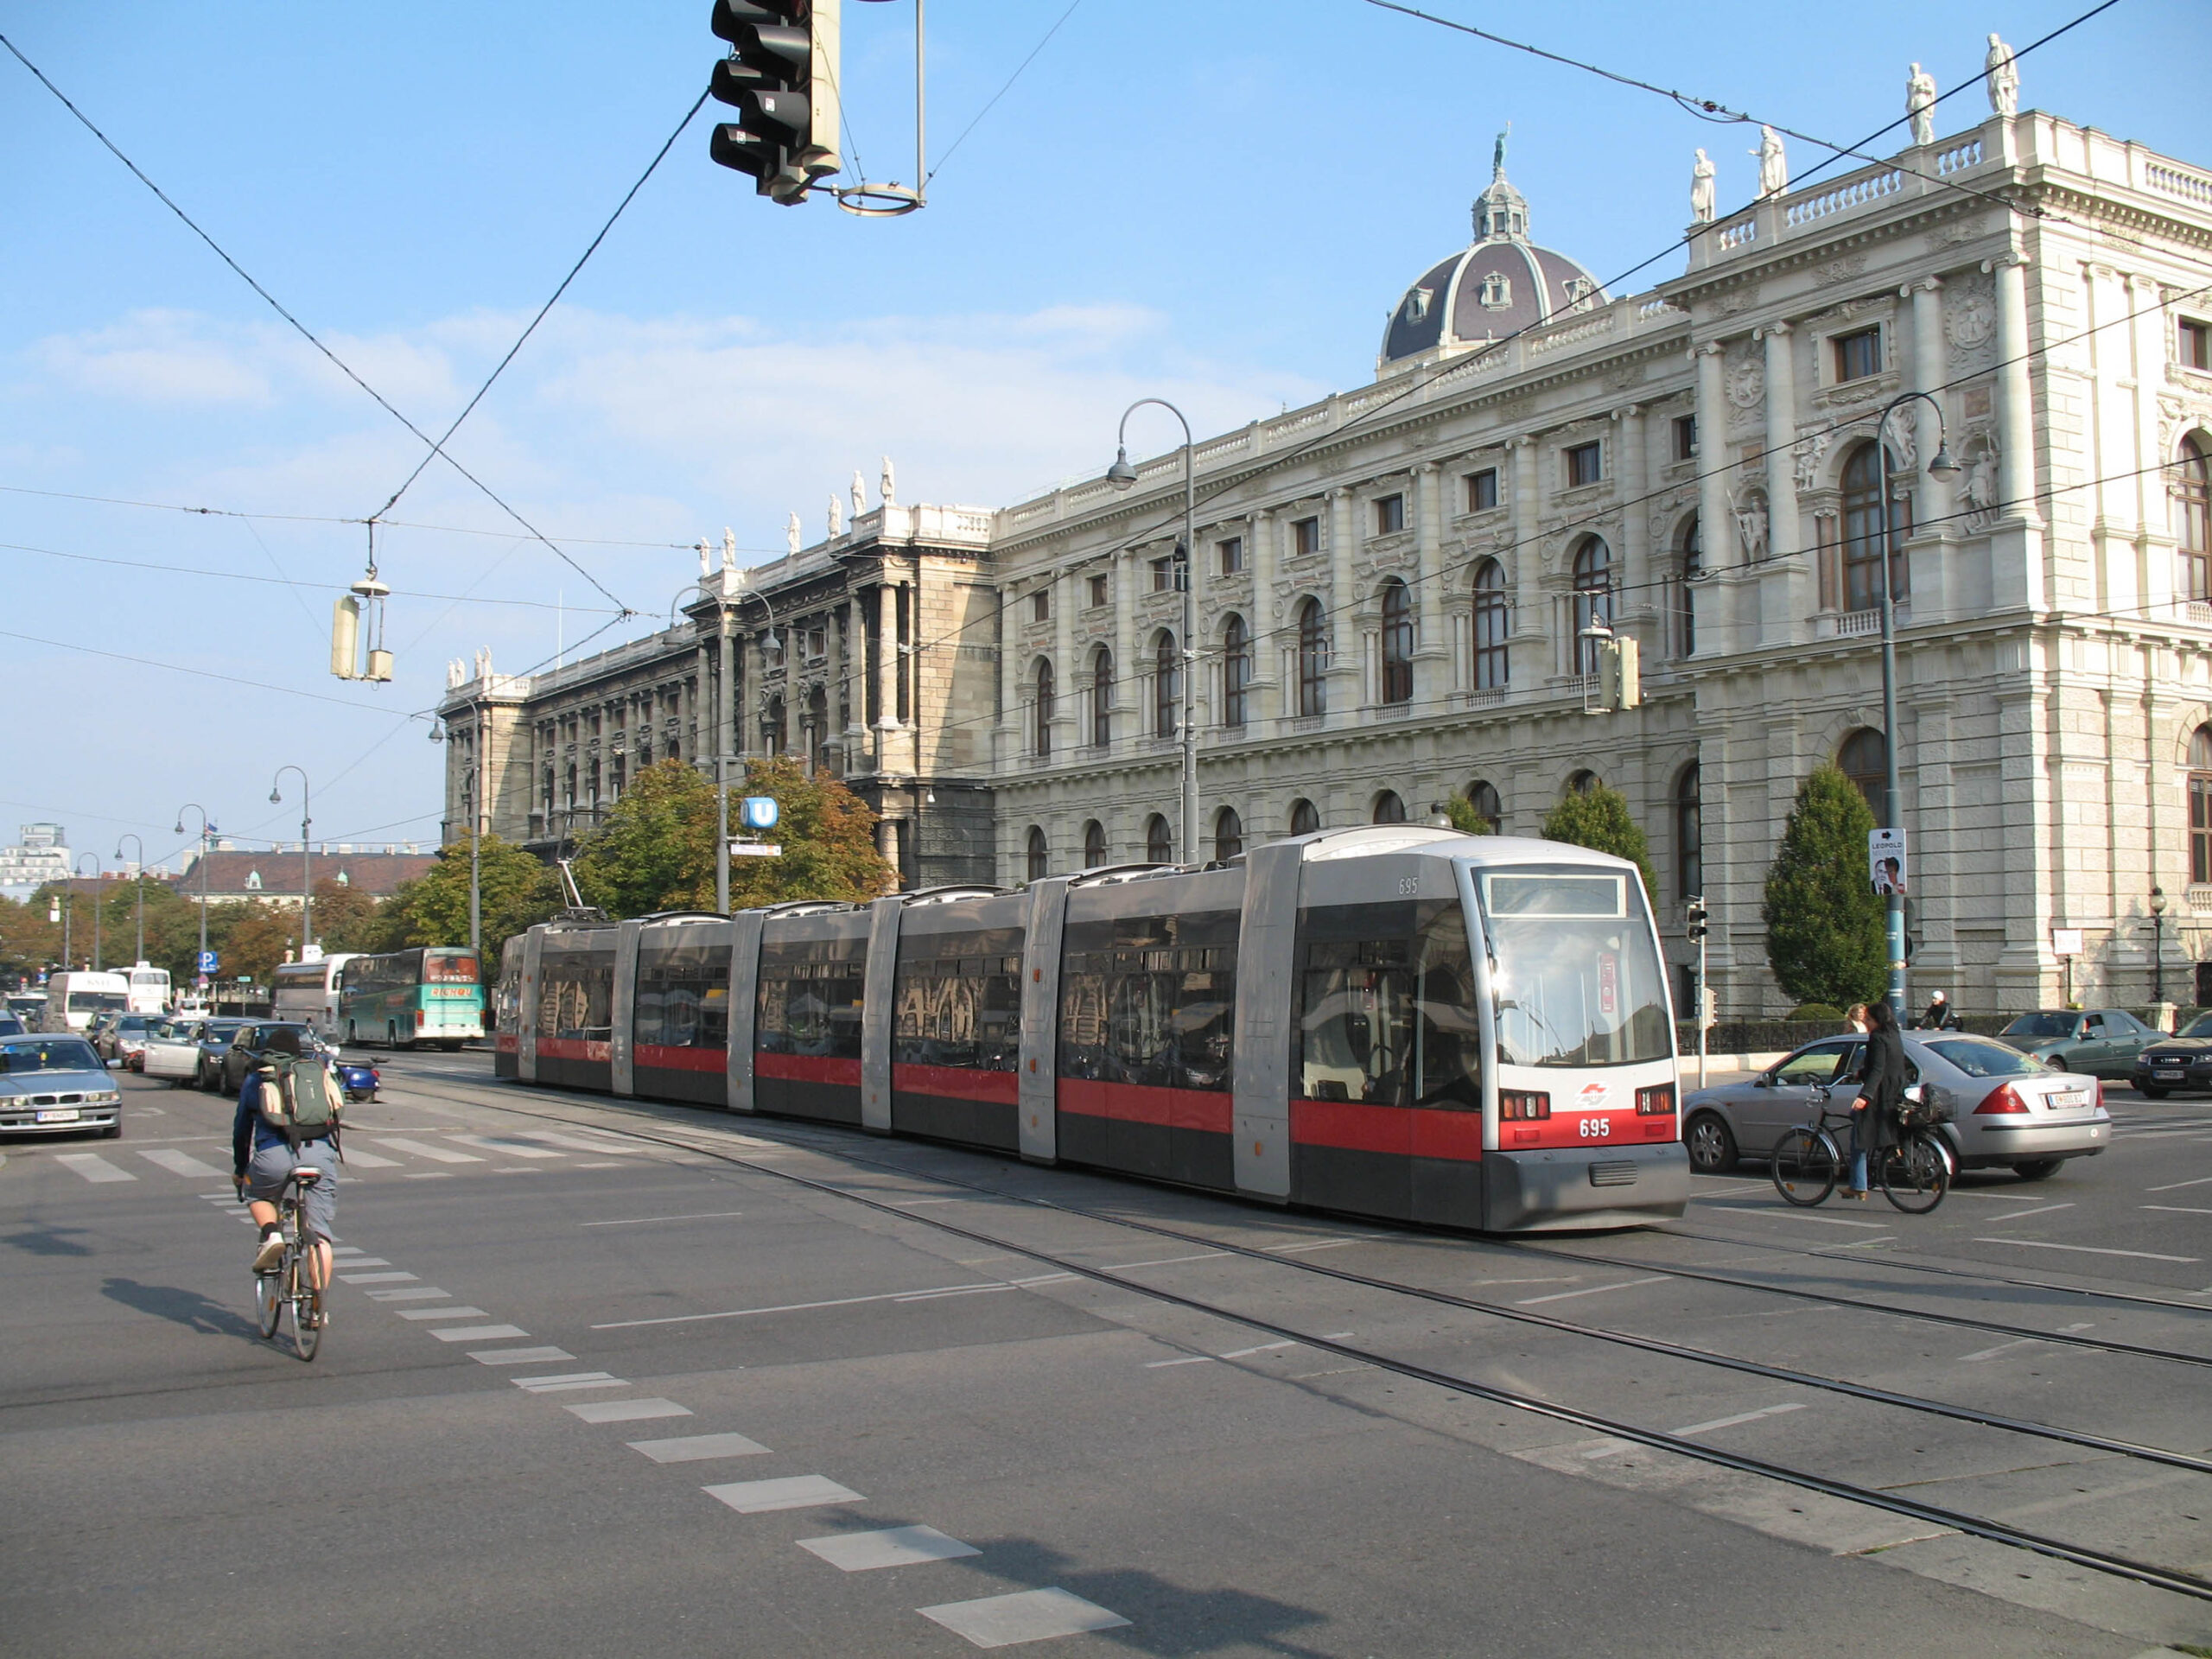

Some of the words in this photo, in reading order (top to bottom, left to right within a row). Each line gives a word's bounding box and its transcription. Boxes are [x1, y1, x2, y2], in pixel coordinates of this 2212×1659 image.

[754, 803, 774, 824] U
[1872, 842, 1903, 850] LEOPOLD
[1399, 877, 1418, 895] 695
[202, 952, 213, 967] P
[430, 988, 473, 997] RICHOU
[1580, 1117, 1611, 1138] 695
